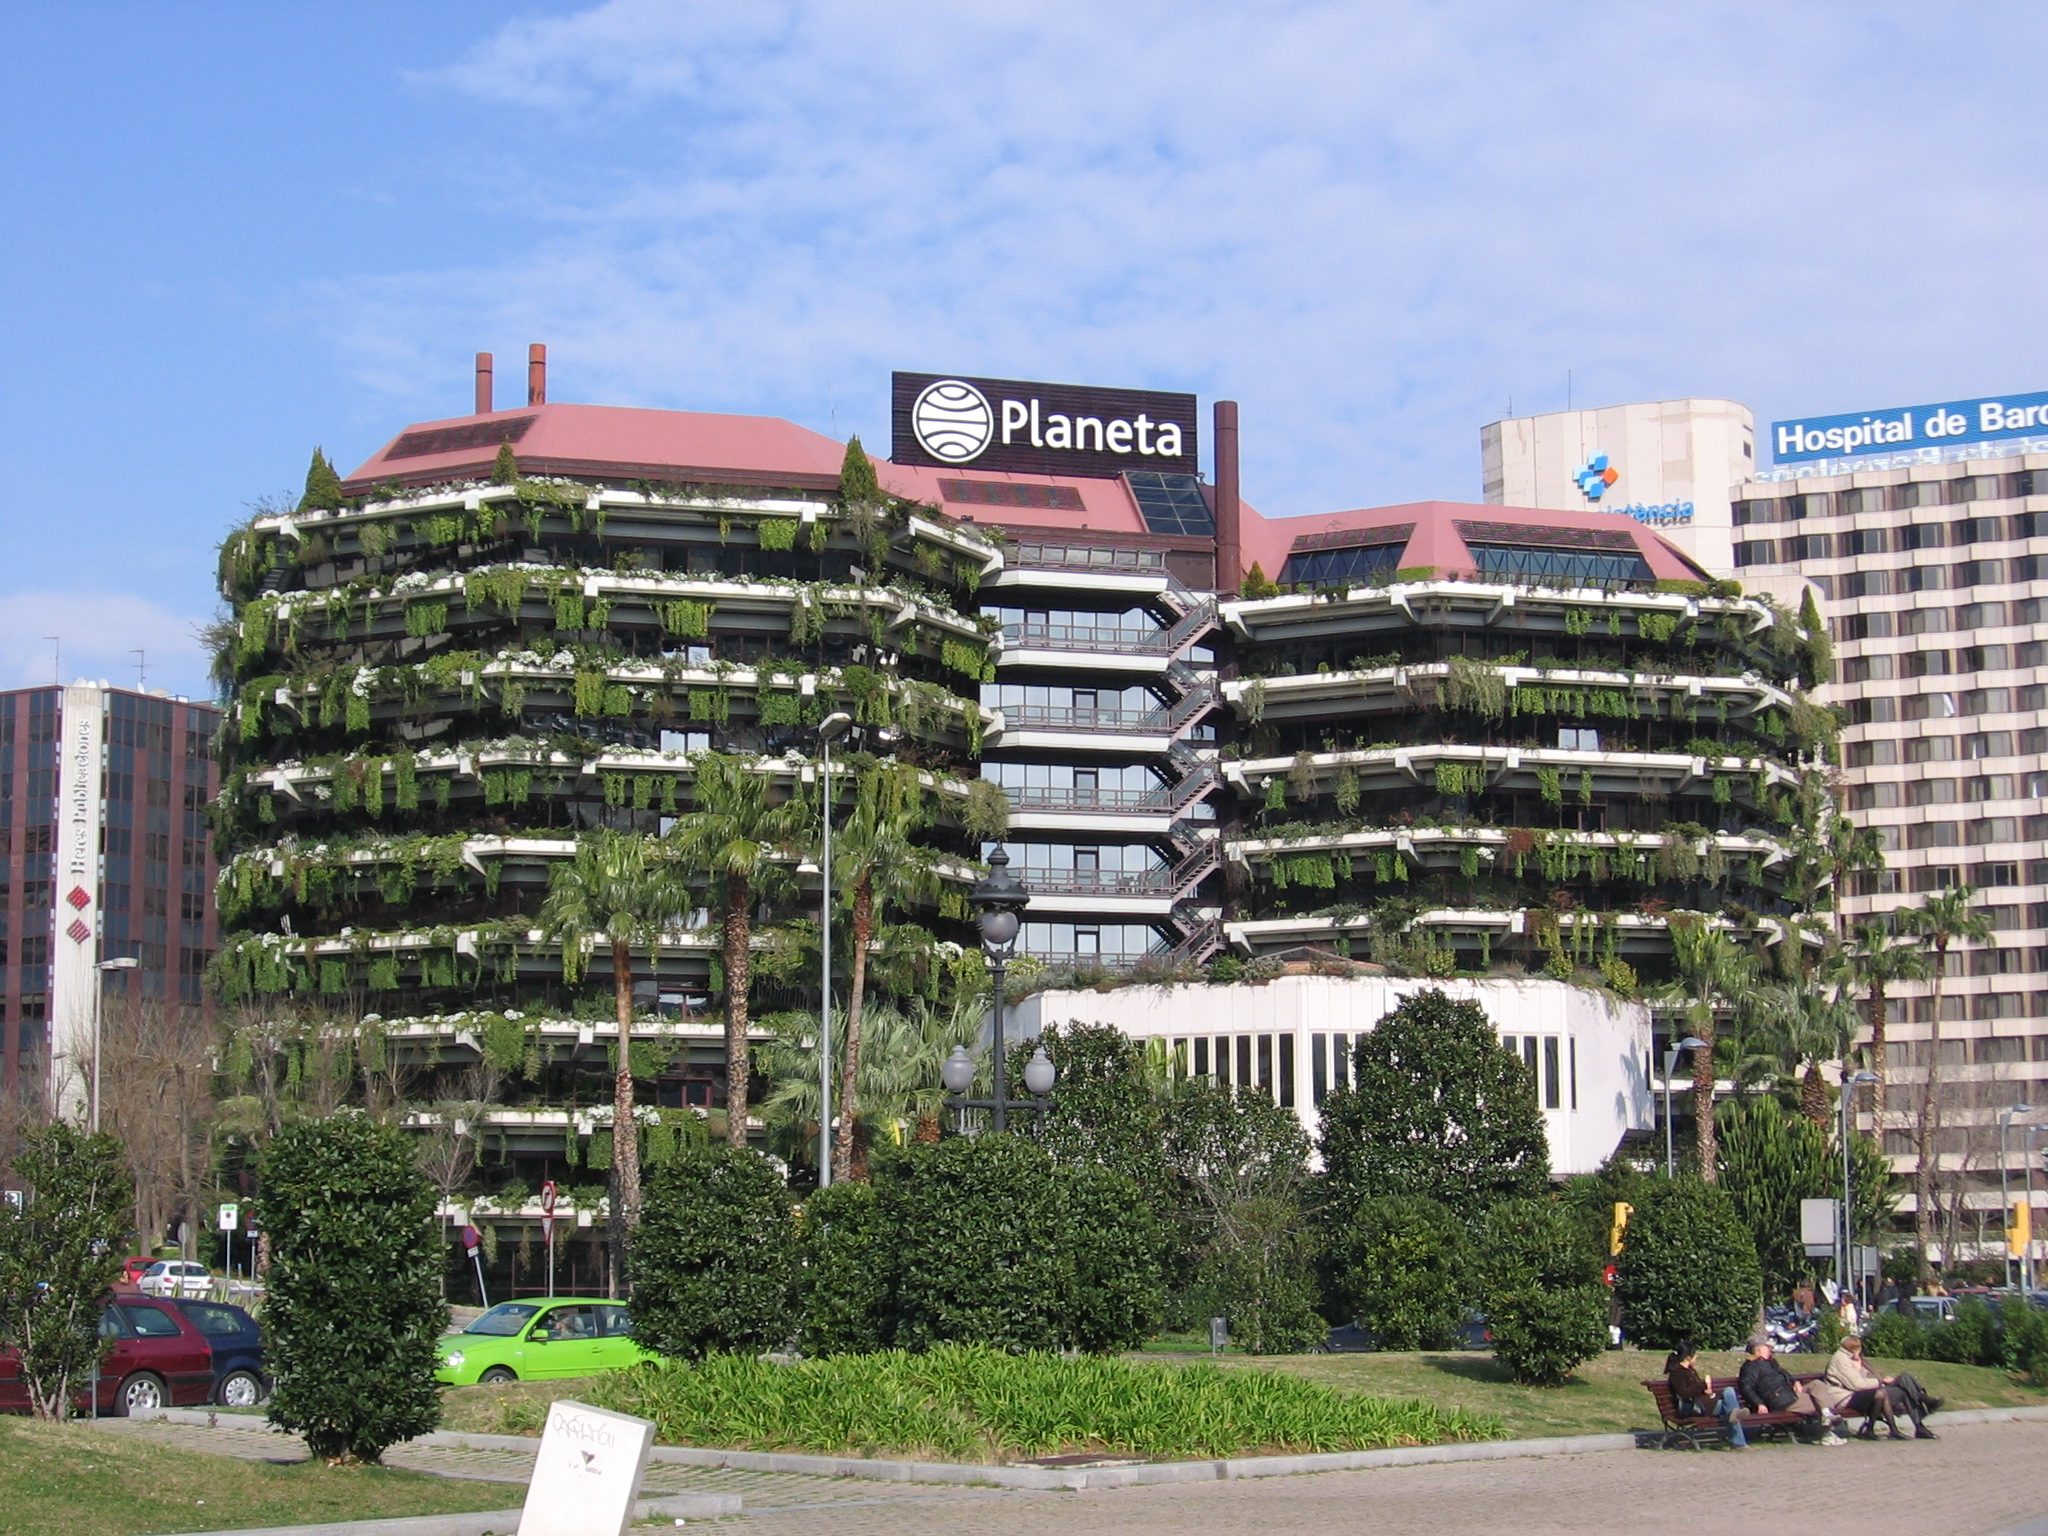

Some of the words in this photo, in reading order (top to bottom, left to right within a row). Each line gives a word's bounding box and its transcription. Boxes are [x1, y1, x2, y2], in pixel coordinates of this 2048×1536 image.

[1002, 398, 1182, 457] Planeta
[1777, 411, 1914, 454] Hospital
[1925, 408, 1967, 438] de
[73, 719, 91, 824] Publicaciones
[70, 828, 88, 876] Heres
